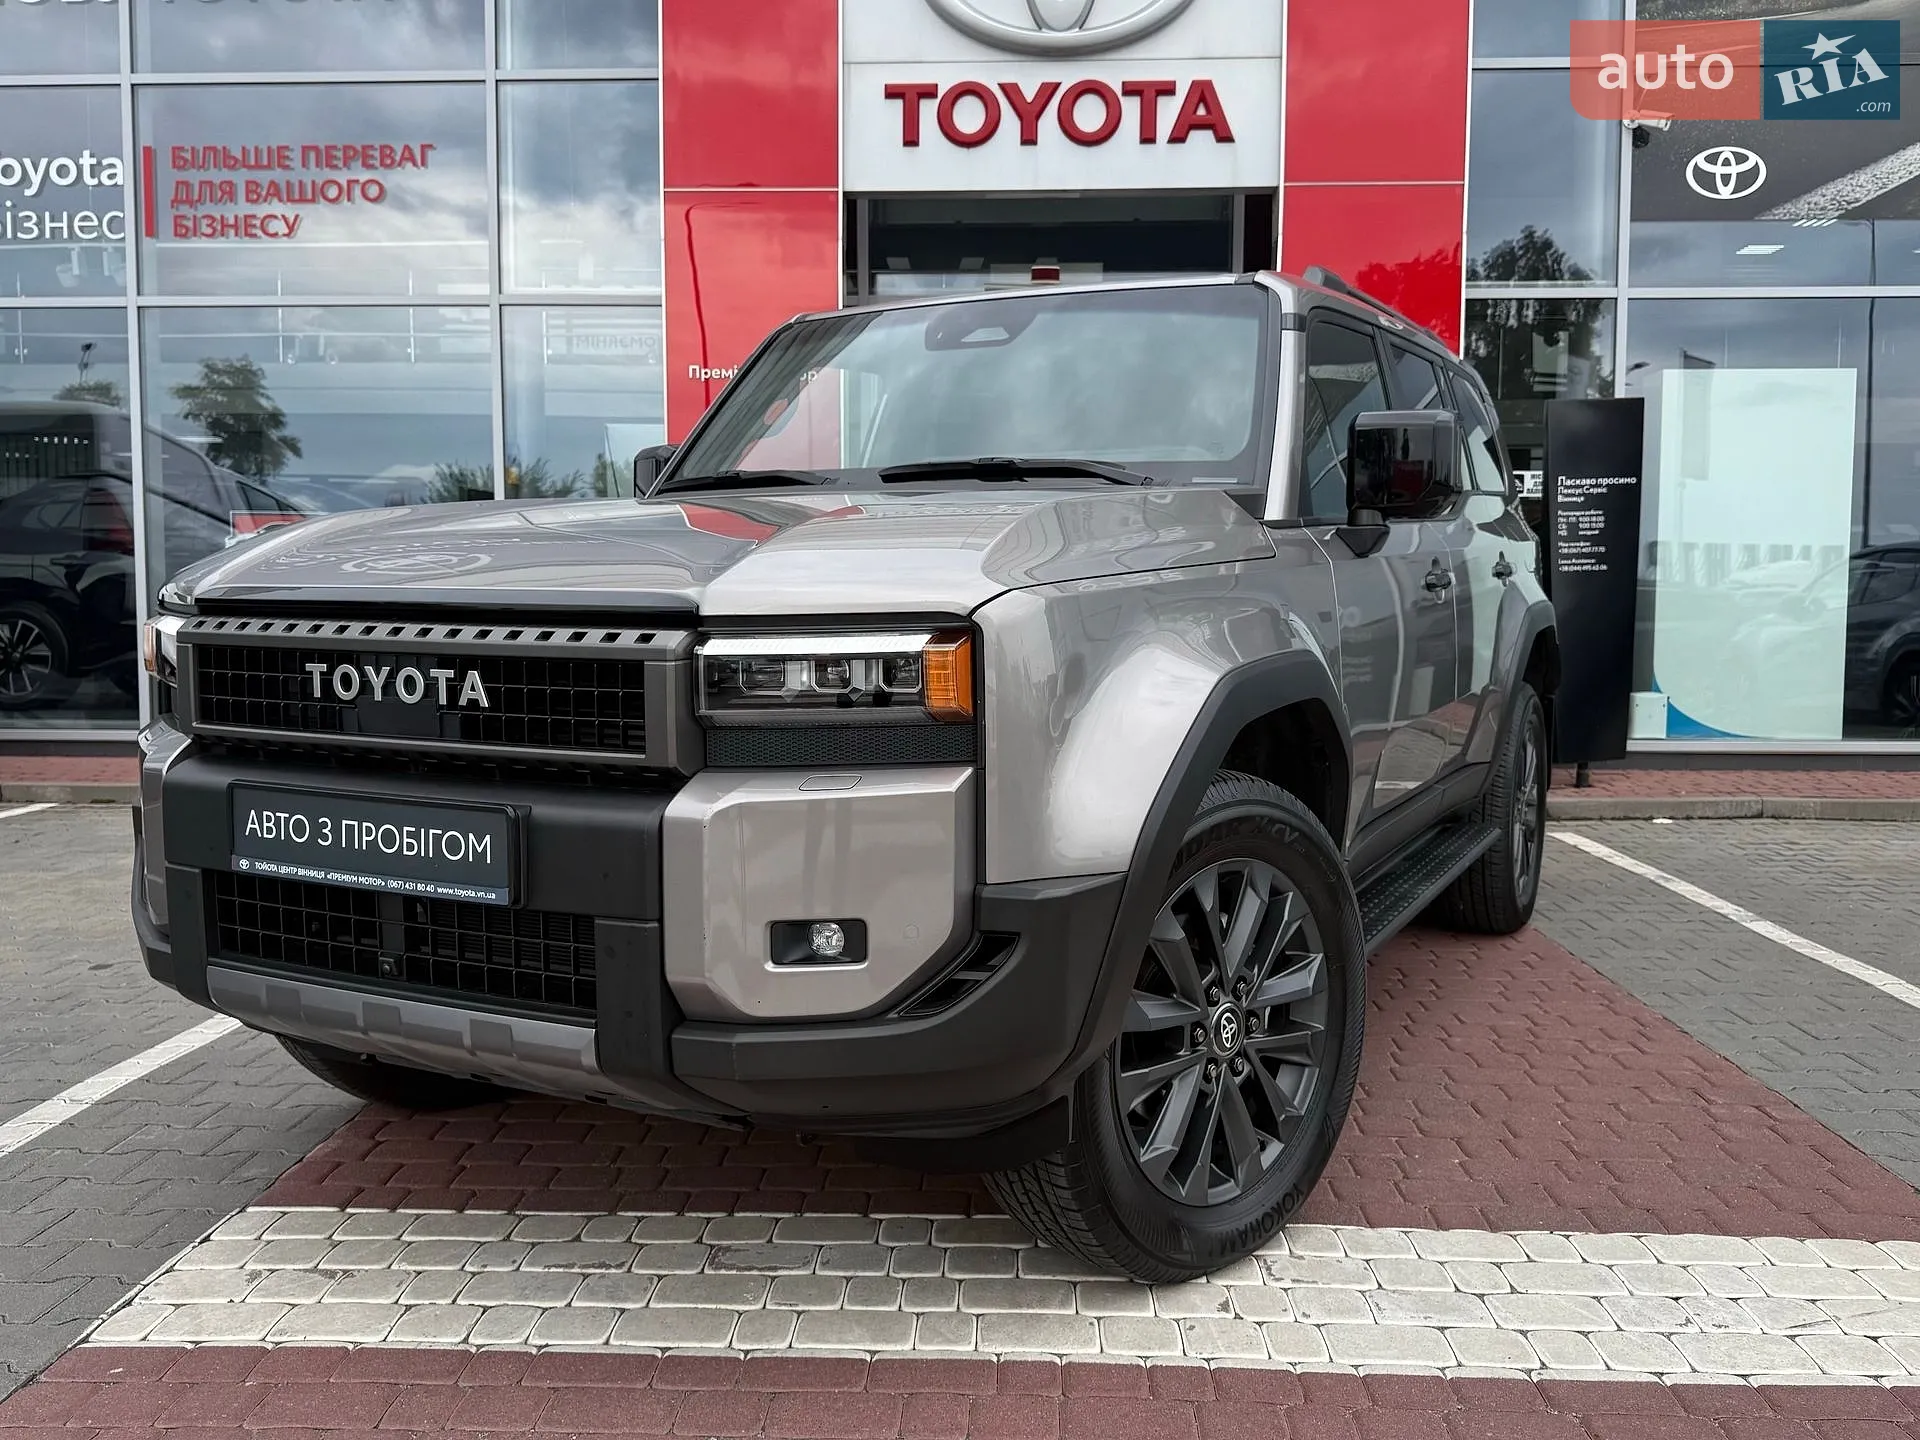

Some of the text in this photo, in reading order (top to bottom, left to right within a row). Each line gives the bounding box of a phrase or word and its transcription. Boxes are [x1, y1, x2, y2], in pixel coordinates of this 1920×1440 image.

[885, 79, 1236, 148] TOYOTA
[0, 149, 124, 196] oyota
[171, 143, 434, 170] БІЛЬШЕ ПЕРЕВАГ
[171, 178, 386, 208] ДЛЯ ВАШОГО
[0, 200, 125, 240] ізнес
[172, 213, 300, 238] БІЗНЕСУ
[688, 364, 740, 382] Премі
[1597, 476, 1637, 486] просимо
[305, 663, 489, 708] TOYOTA
[245, 809, 492, 865] АВТО З ПРОБІГОМ
[254, 860, 279, 873] ТОЙОТА
[278, 865, 298, 876] ЦЕНТР
[297, 868, 325, 880] ВІННИЦЯ
[387, 879, 405, 891] (067)
[404, 881, 416, 891] 431
[416, 883, 426, 892] 80
[425, 884, 435, 893] 40
[436, 886, 496, 900] www.toyota.vn.ua
